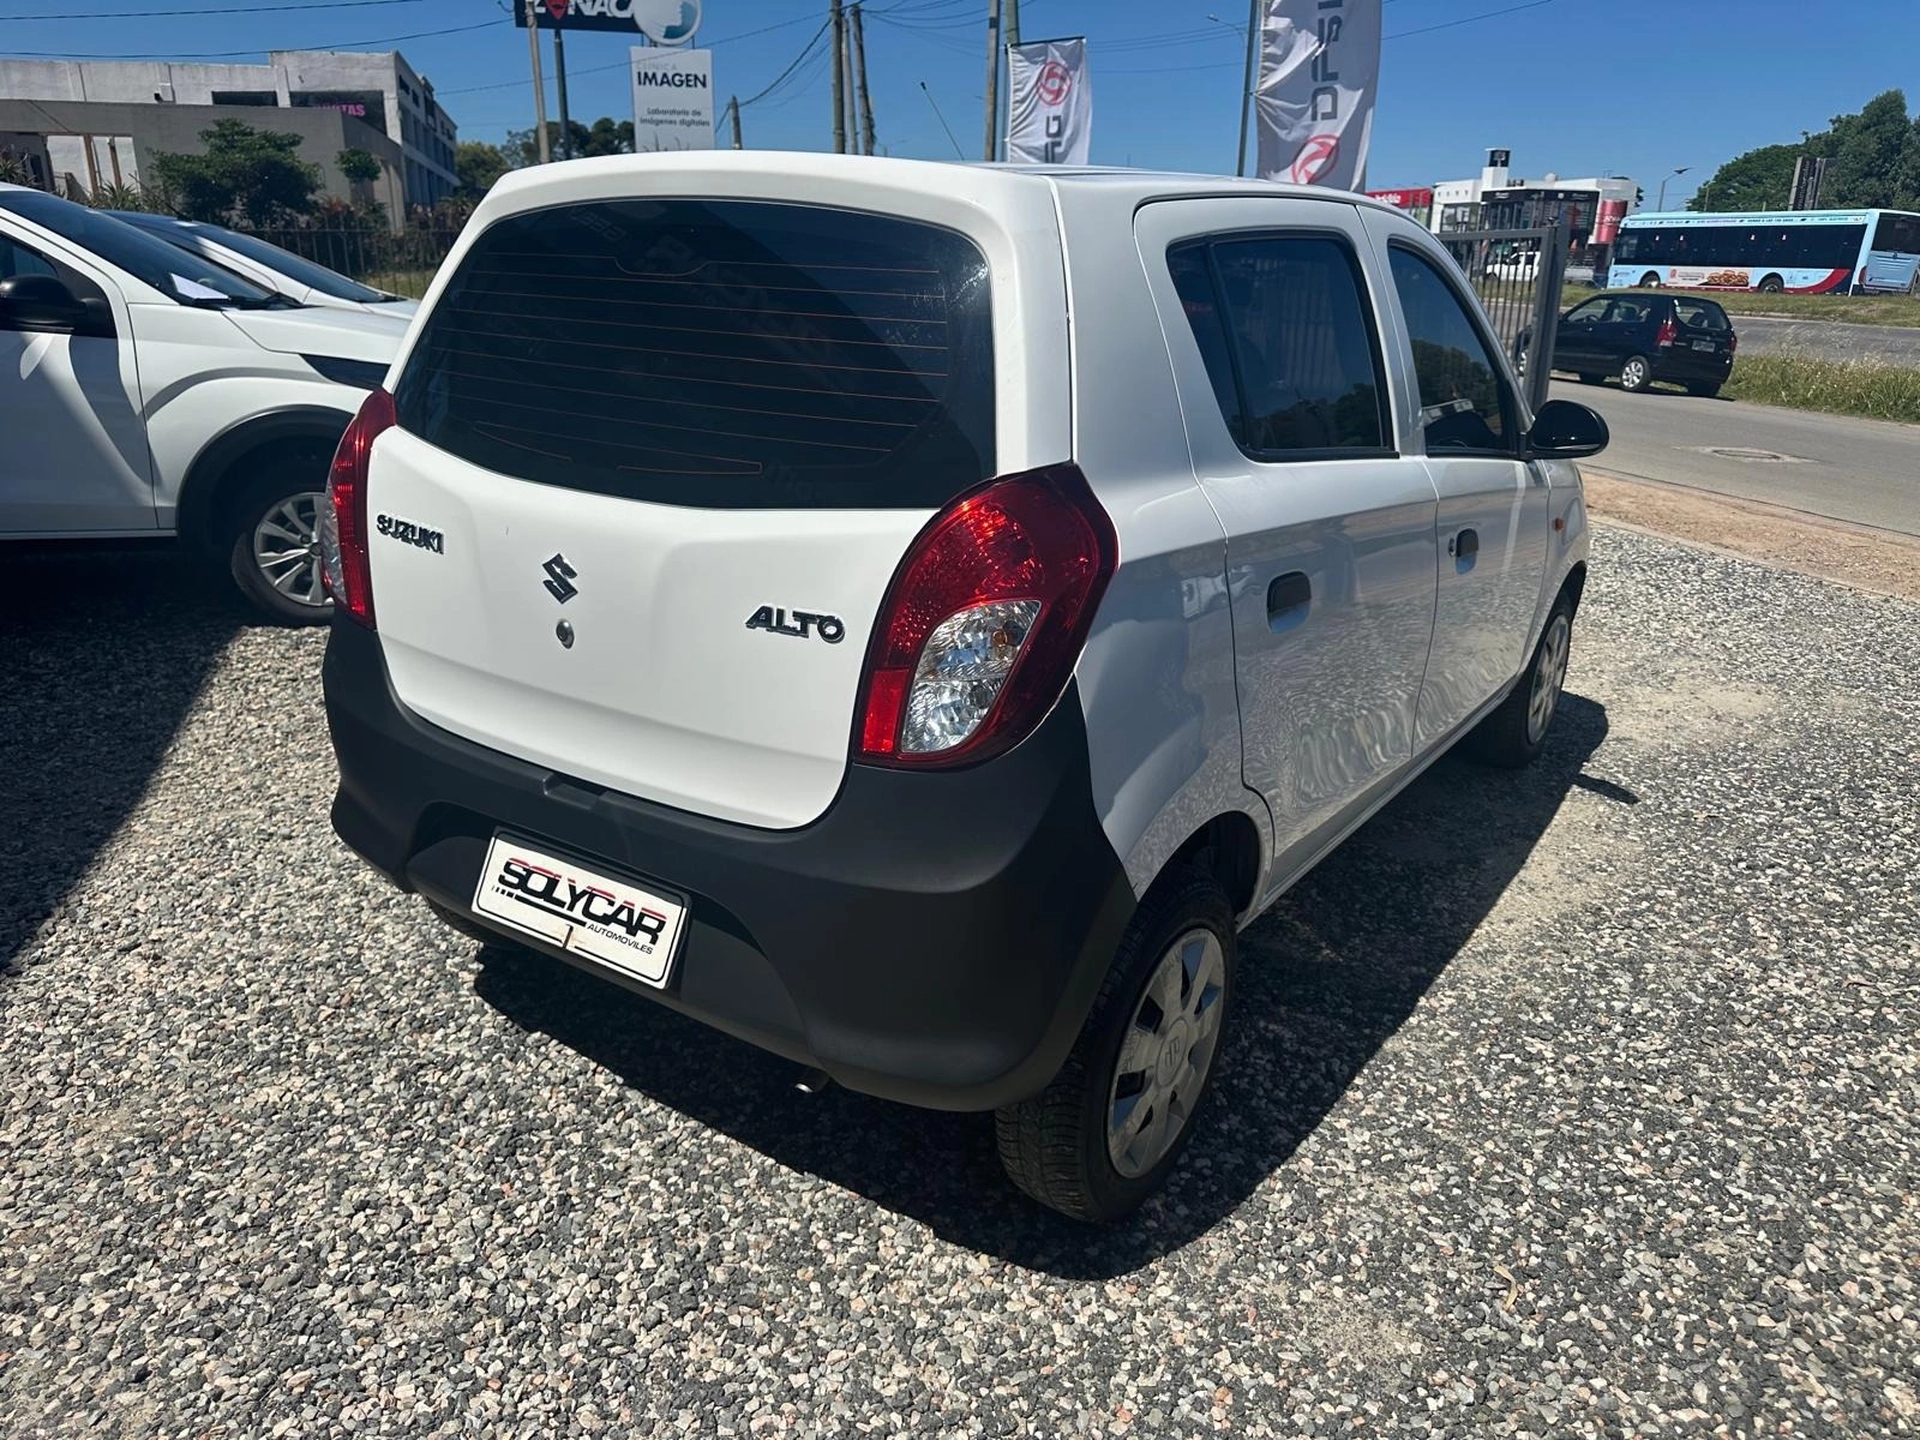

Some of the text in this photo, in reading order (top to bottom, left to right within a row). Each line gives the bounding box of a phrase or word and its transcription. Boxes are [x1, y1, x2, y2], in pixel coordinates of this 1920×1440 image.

[637, 71, 707, 89] IMAGEN
[647, 107, 702, 117] Laboratorio de
[679, 118, 710, 127] digitales
[376, 514, 444, 555] SUZUKI
[745, 605, 845, 644] ALTO
[497, 857, 667, 945] SOLYCAR
[587, 923, 653, 955] AUTOMOVILES
